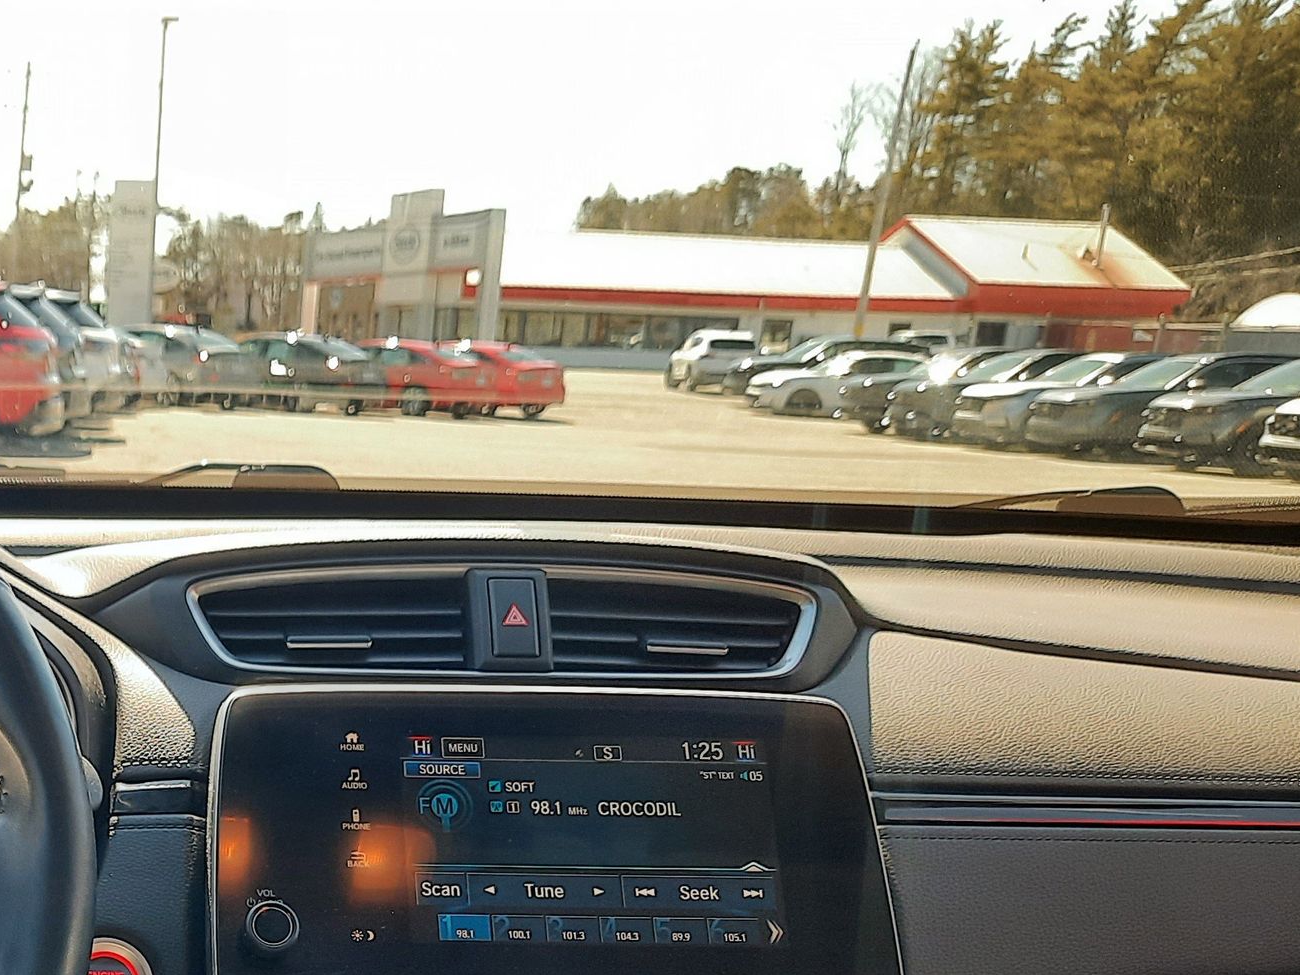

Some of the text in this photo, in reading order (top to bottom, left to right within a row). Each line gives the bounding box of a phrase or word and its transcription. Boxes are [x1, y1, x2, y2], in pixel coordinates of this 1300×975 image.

[414, 740, 431, 755] Hi
[449, 743, 478, 753] MENU
[682, 742, 723, 760] 1:25
[738, 745, 755, 759] Hi
[419, 764, 466, 775] SOURCE
[718, 771, 734, 780] TEXT
[750, 771, 763, 781] 05
[505, 782, 534, 793] SOFT
[419, 796, 457, 814] FM
[531, 801, 682, 816] 98.1 MHz CROCODIL
[257, 889, 276, 897] VOL
[421, 881, 719, 900] Scan Tune Seek
[456, 930, 474, 938] 98.1
[508, 930, 531, 939] 100.1
[562, 931, 585, 940] 101.3
[616, 932, 639, 941] 104.3
[672, 932, 690, 942] 89.9
[724, 933, 746, 942] 105.1
